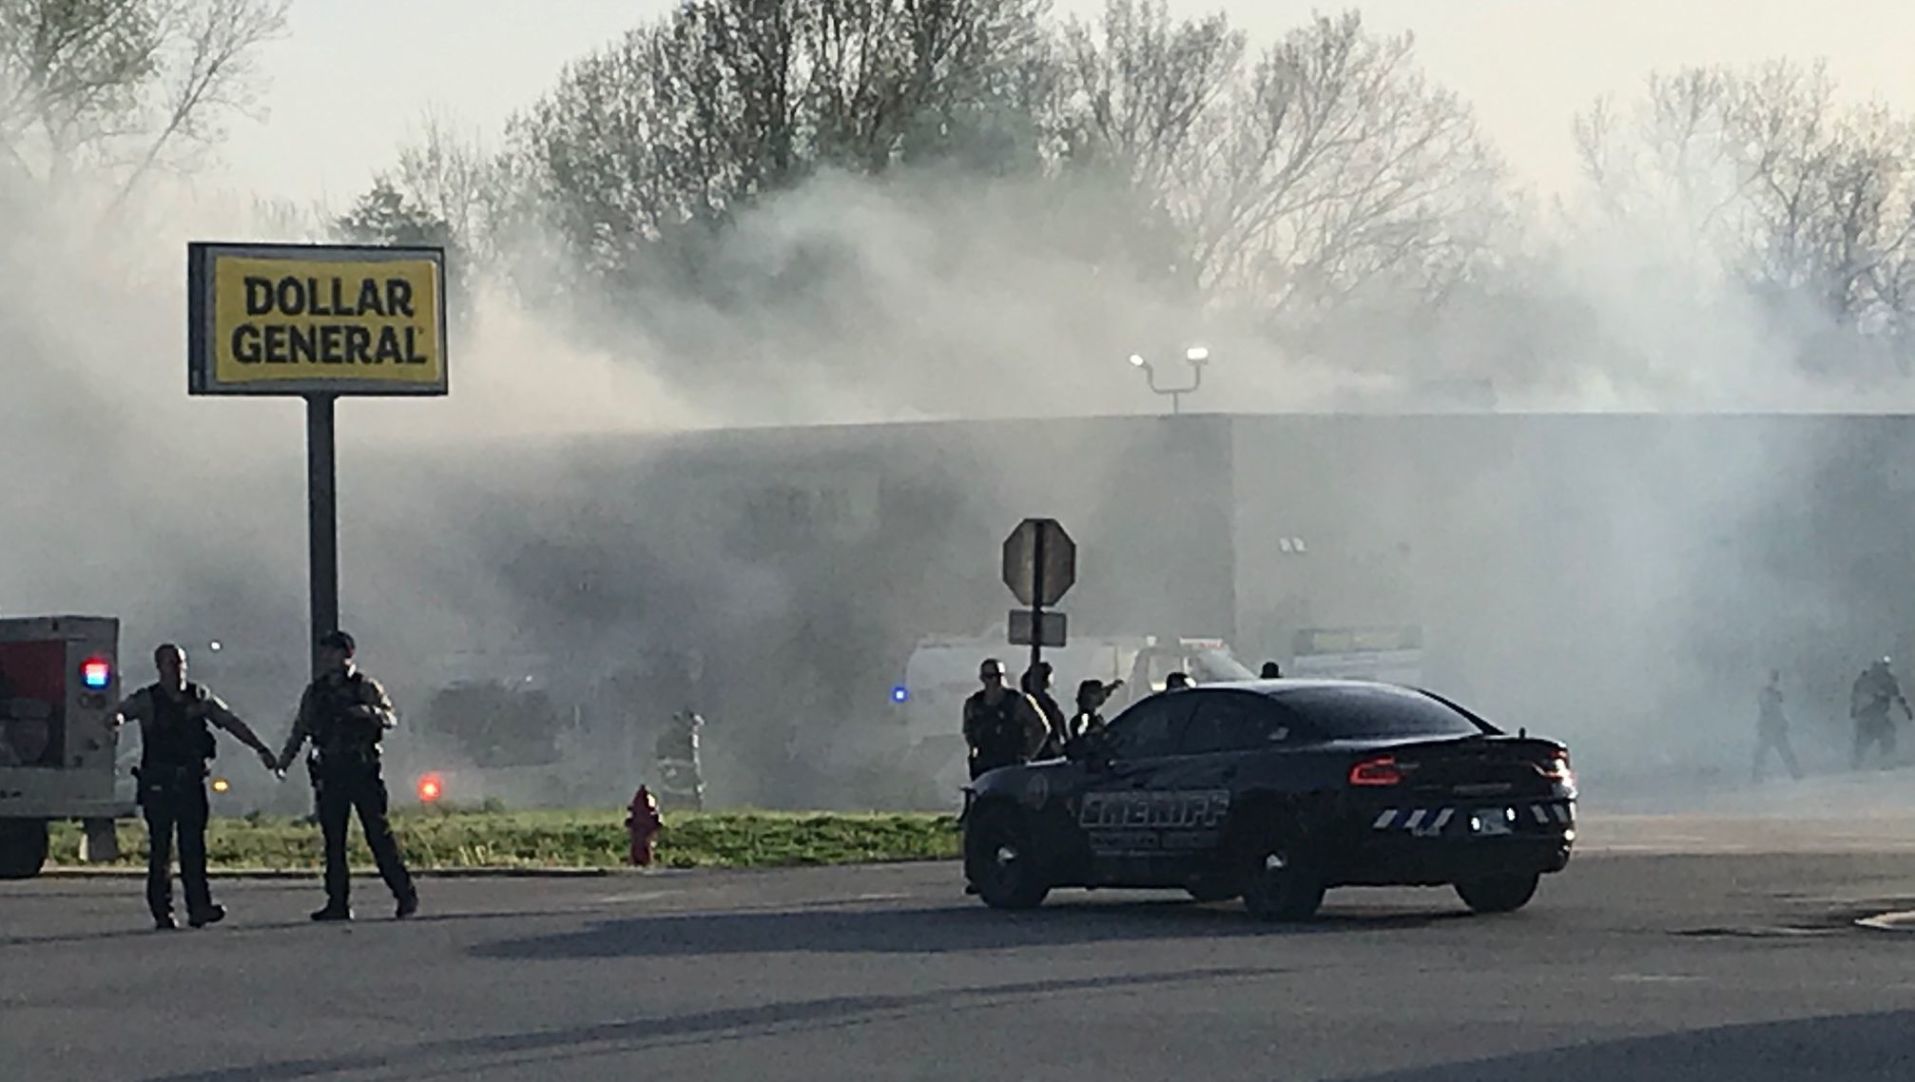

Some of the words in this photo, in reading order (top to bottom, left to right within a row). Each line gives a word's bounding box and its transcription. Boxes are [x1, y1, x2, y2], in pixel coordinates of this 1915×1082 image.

[244, 276, 414, 317] DOLLAR
[231, 323, 427, 364] GENERAL
[1079, 790, 1230, 828] SHERIFF
